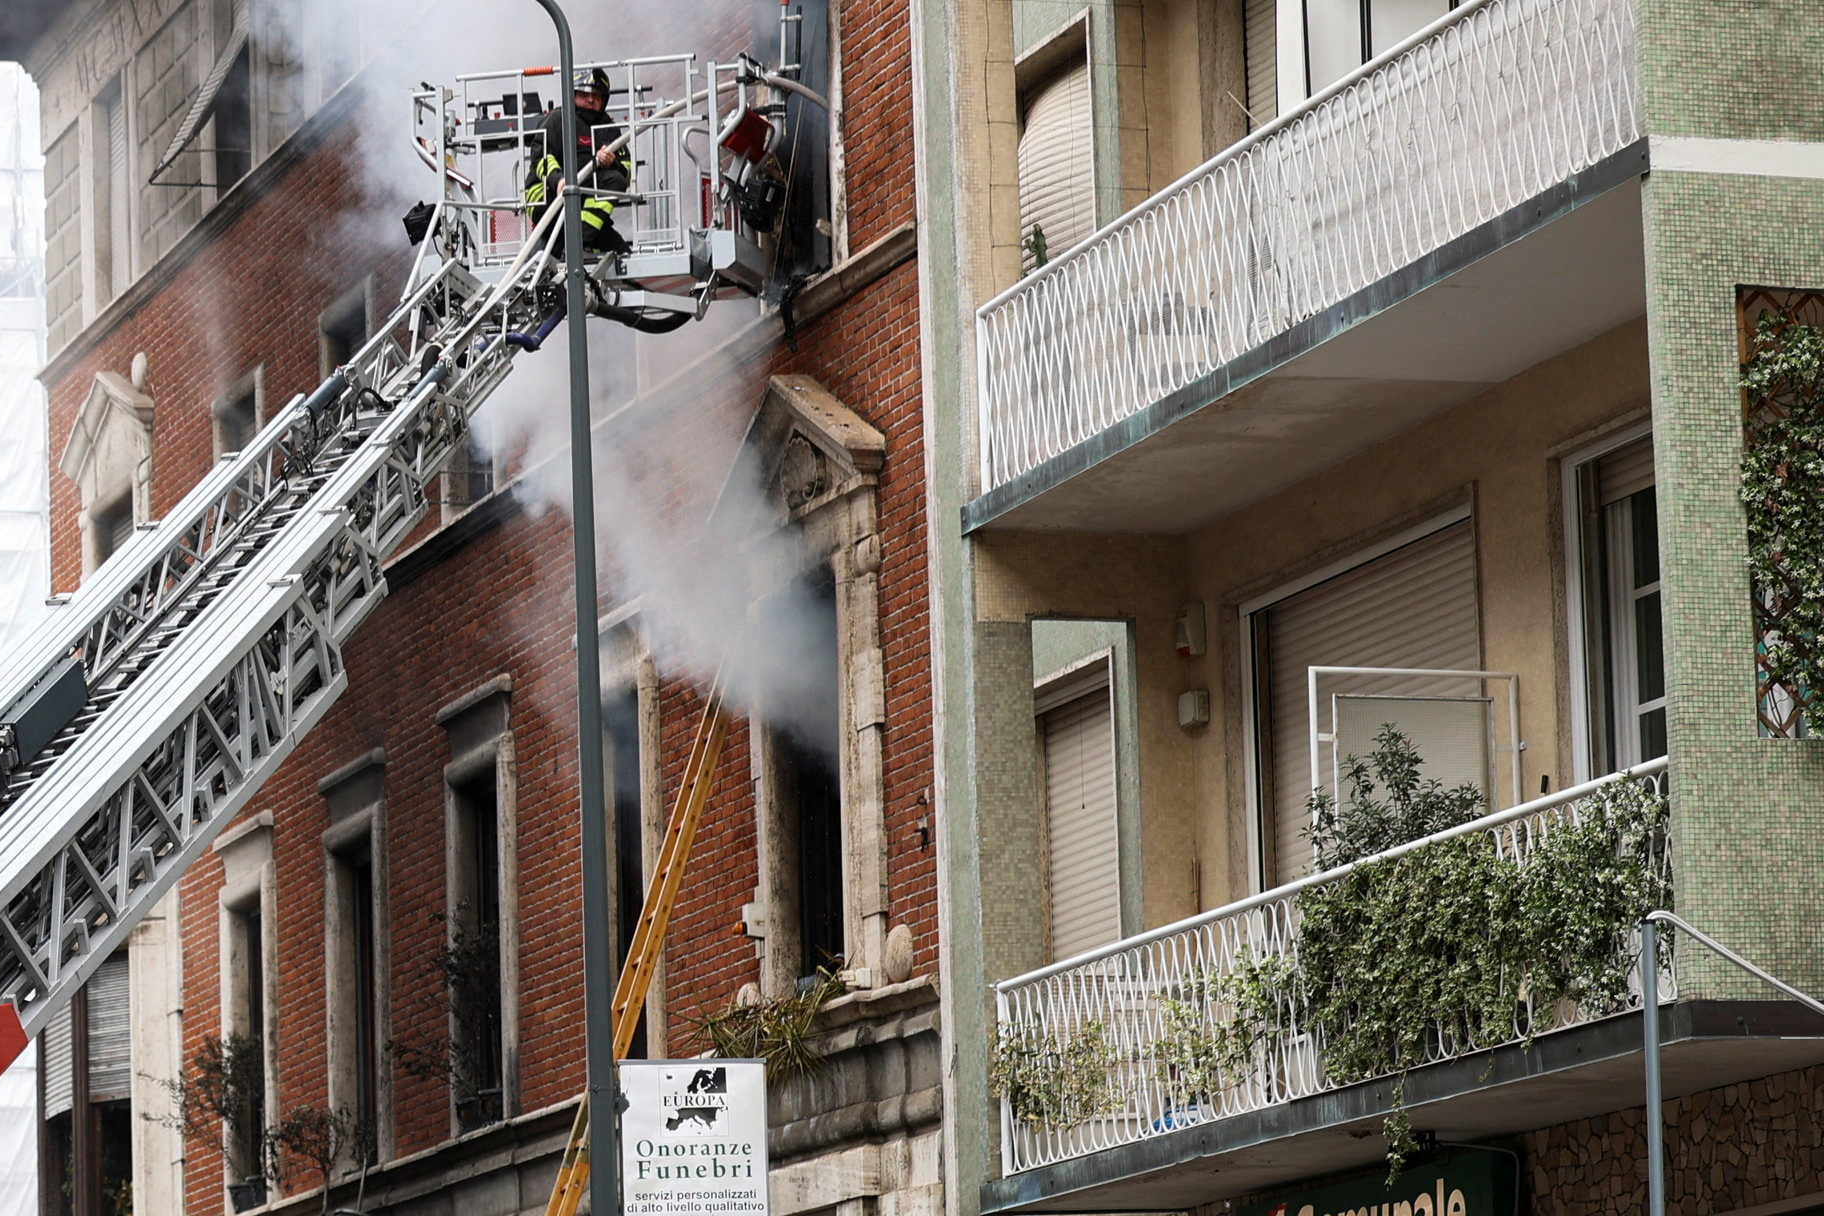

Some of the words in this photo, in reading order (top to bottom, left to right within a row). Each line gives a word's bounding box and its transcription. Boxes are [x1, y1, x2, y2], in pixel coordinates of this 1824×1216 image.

[663, 1095, 725, 1107] EUROPA
[636, 1139, 752, 1158] Onoranze
[636, 1158, 753, 1180] Funebri
[635, 1190, 673, 1201] servizi
[677, 1189, 757, 1202] personalizzati
[627, 1202, 638, 1213] di
[641, 1202, 663, 1213] alto
[666, 1202, 702, 1212] livello
[705, 1201, 765, 1214] qualitativo
